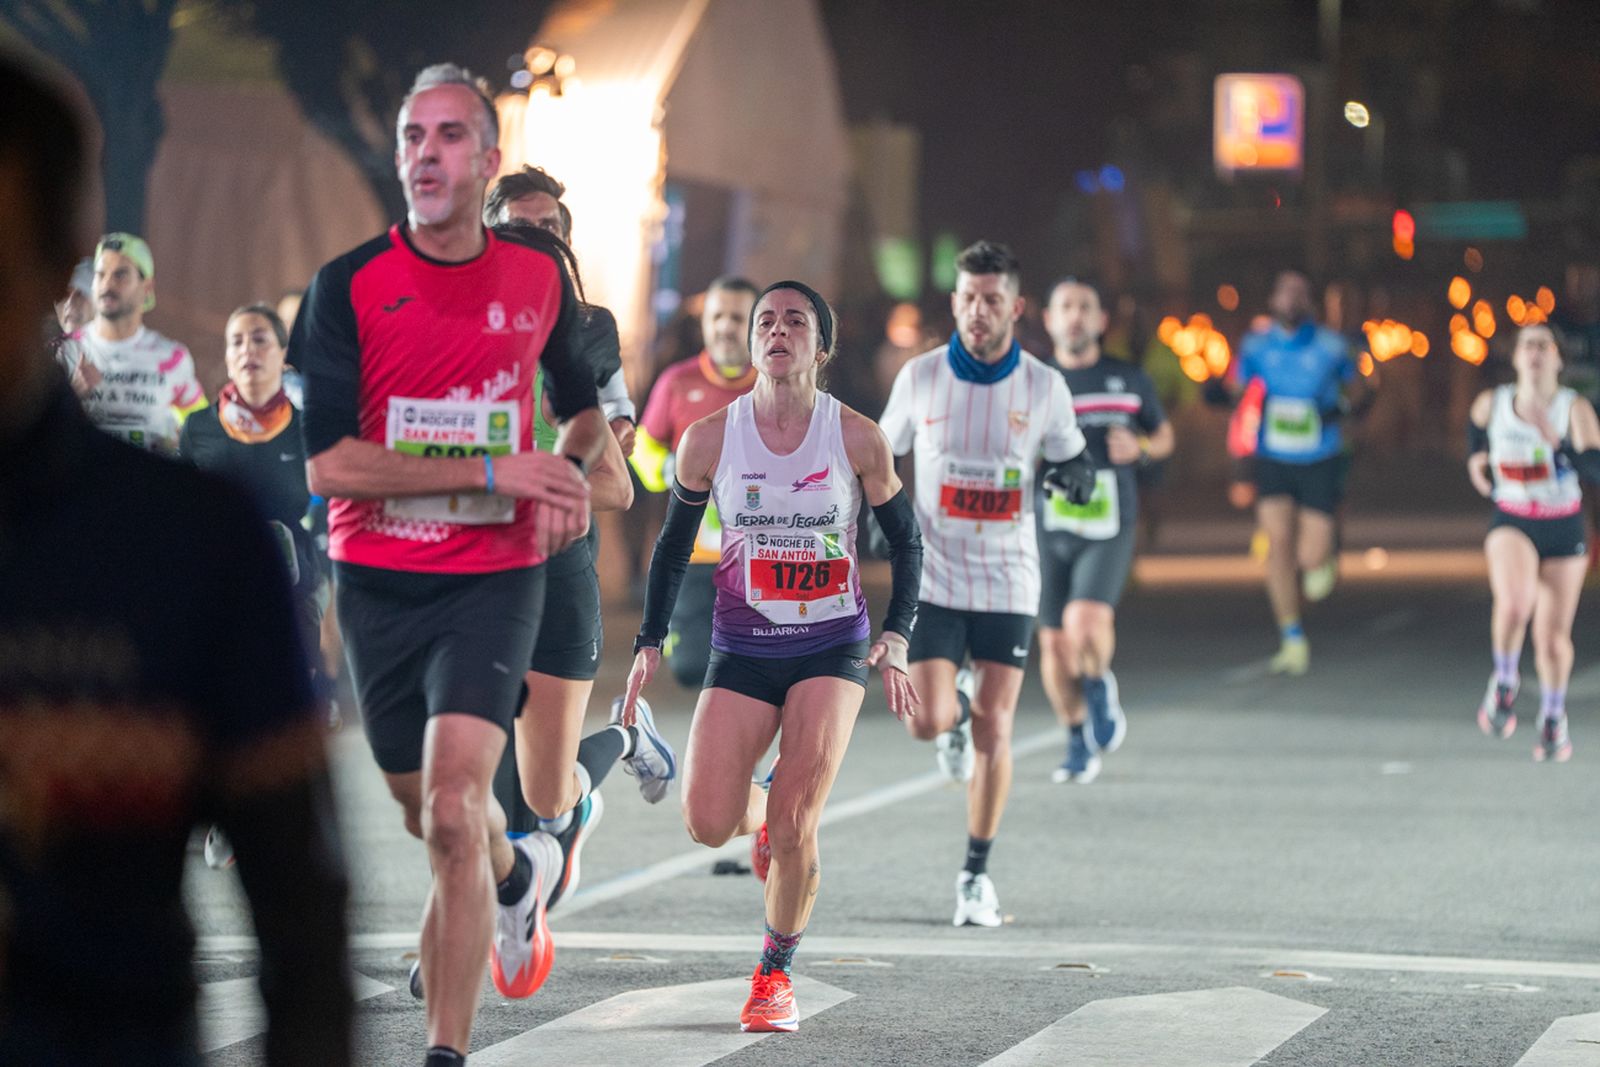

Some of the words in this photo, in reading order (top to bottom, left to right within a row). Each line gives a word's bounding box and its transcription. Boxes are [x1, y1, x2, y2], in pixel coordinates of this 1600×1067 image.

[403, 428, 429, 439] SAN
[741, 472, 767, 480] mobel
[953, 488, 1010, 513] 4202
[735, 513, 776, 528] SIERRA
[777, 516, 789, 525] DE
[788, 513, 836, 528] SEGURA
[769, 538, 801, 549] NOCHE
[803, 539, 816, 549] DE
[757, 548, 779, 559] SAN
[780, 547, 817, 561] ANTÓN
[770, 562, 831, 591] 1726
